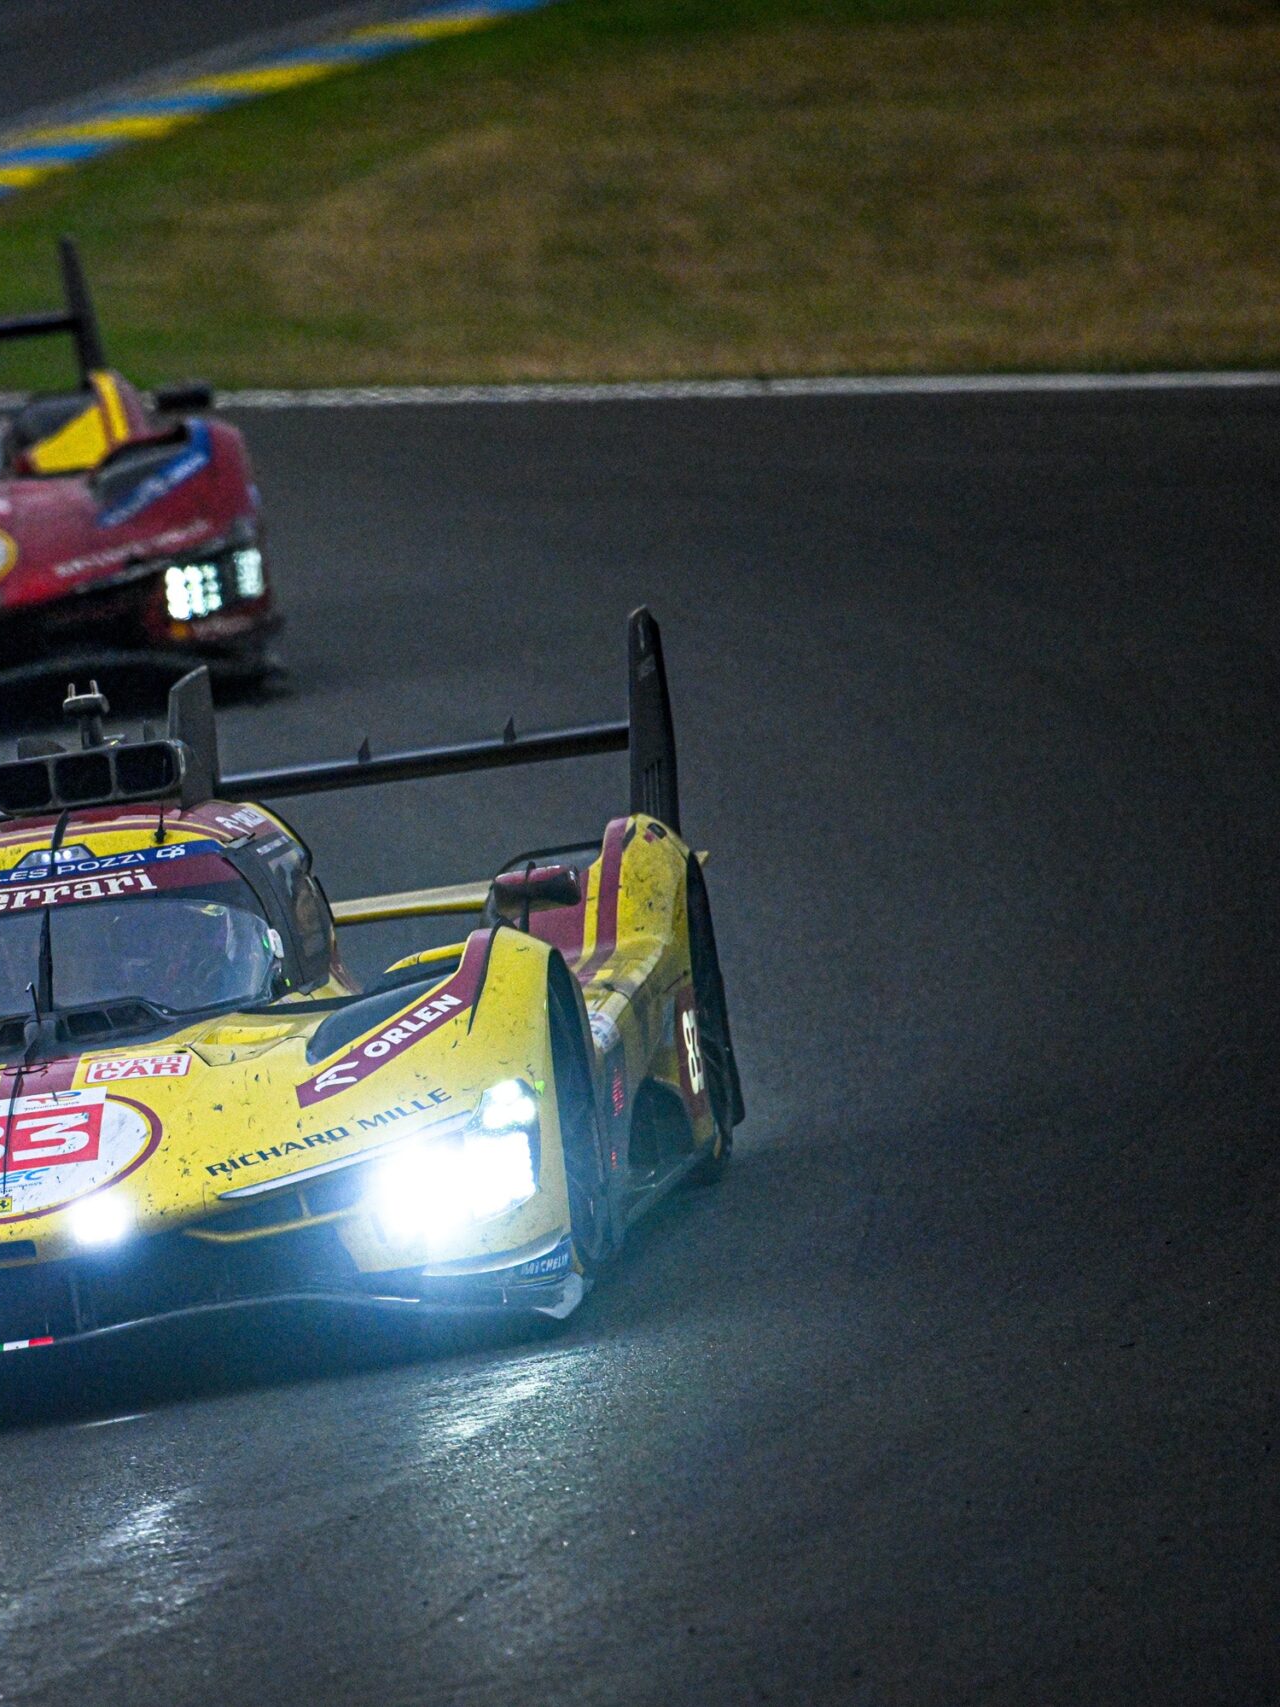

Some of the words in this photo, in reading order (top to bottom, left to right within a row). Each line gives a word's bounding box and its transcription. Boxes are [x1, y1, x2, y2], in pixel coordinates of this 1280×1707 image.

[57, 853, 135, 875] POZZI
[363, 993, 463, 1059] ORLEN
[93, 1063, 181, 1080] CAR
[95, 1056, 183, 1070] HYPER
[205, 1126, 351, 1177] RICHARD
[357, 1087, 453, 1131] MILLE
